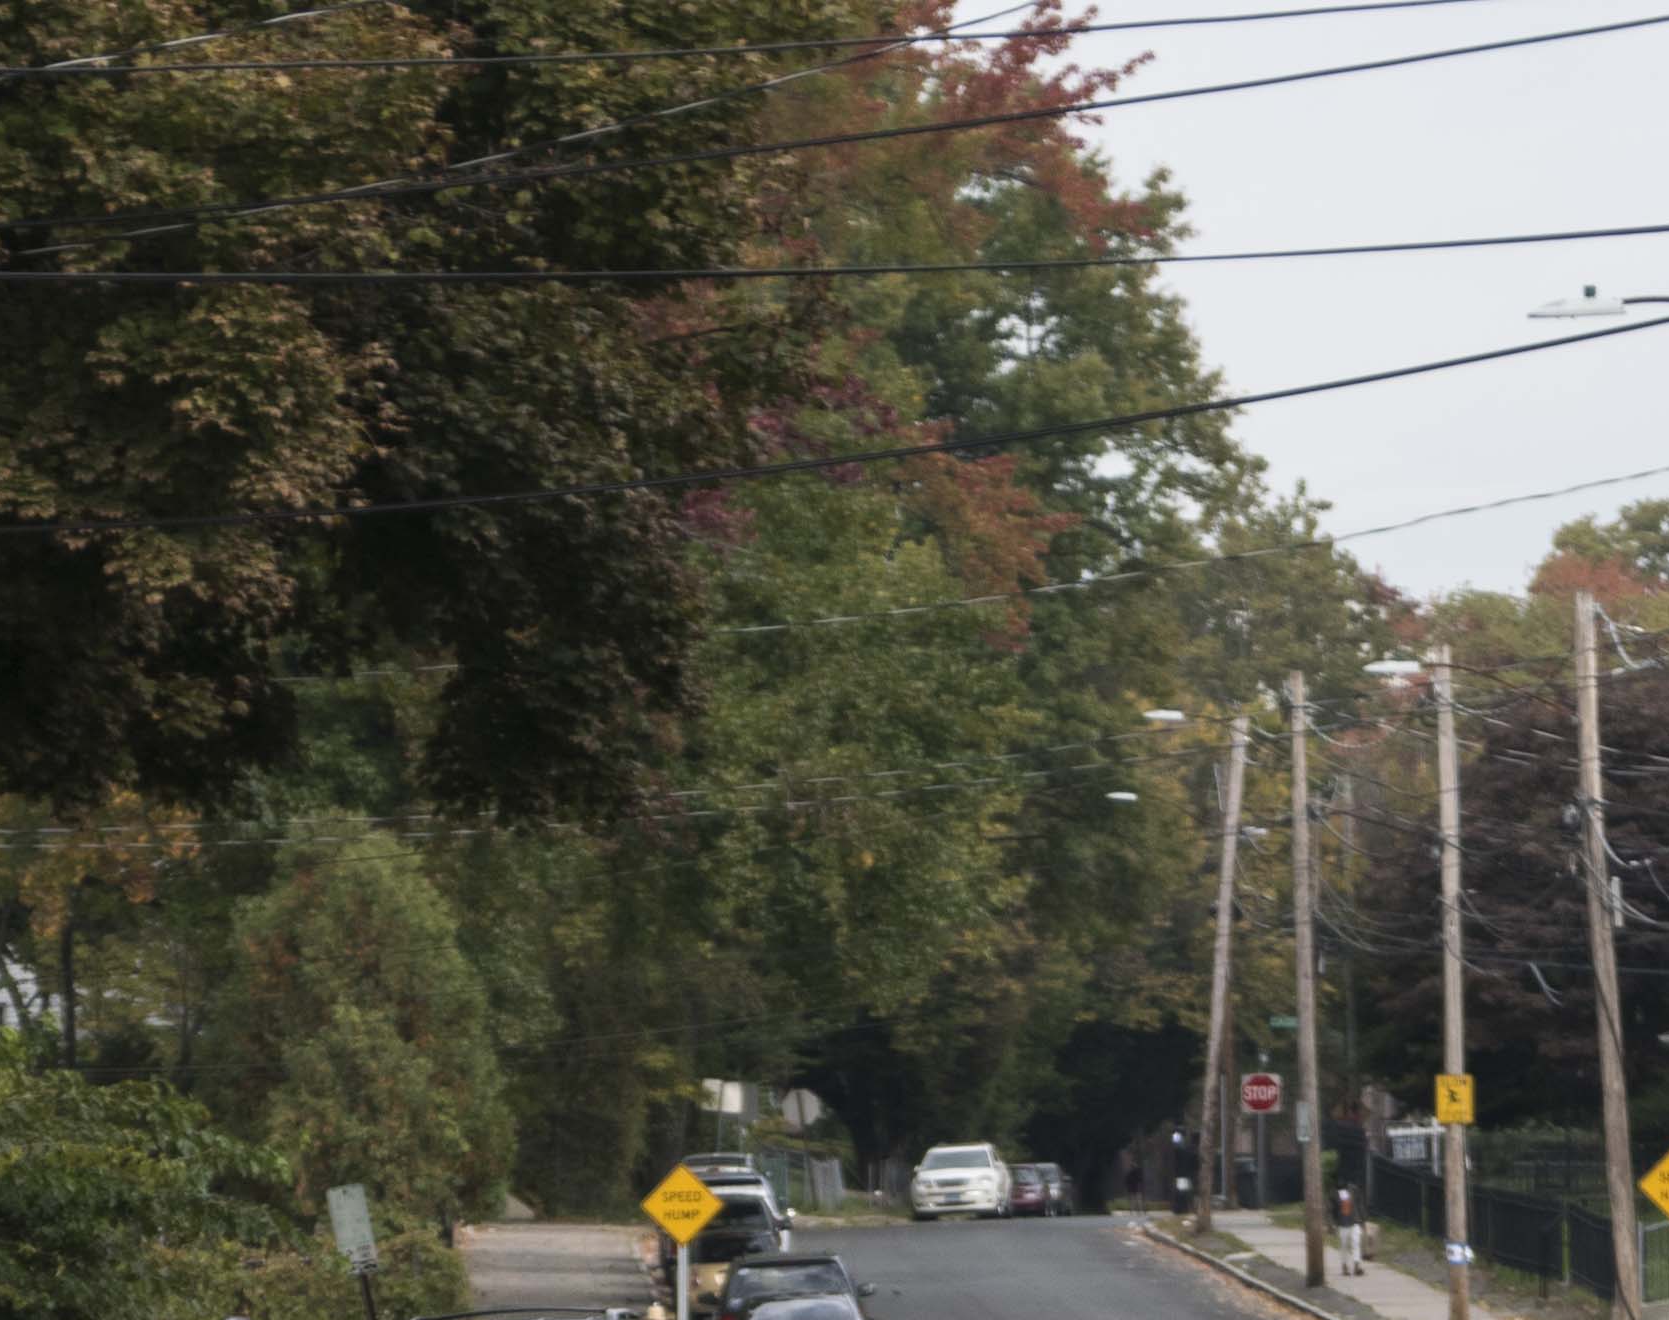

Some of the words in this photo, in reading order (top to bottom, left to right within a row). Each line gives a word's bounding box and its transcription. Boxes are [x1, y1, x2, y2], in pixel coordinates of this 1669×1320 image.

[1243, 1086, 1277, 1100] STOP
[662, 1191, 701, 1203] SPEED
[664, 1209, 700, 1220] HUMP
